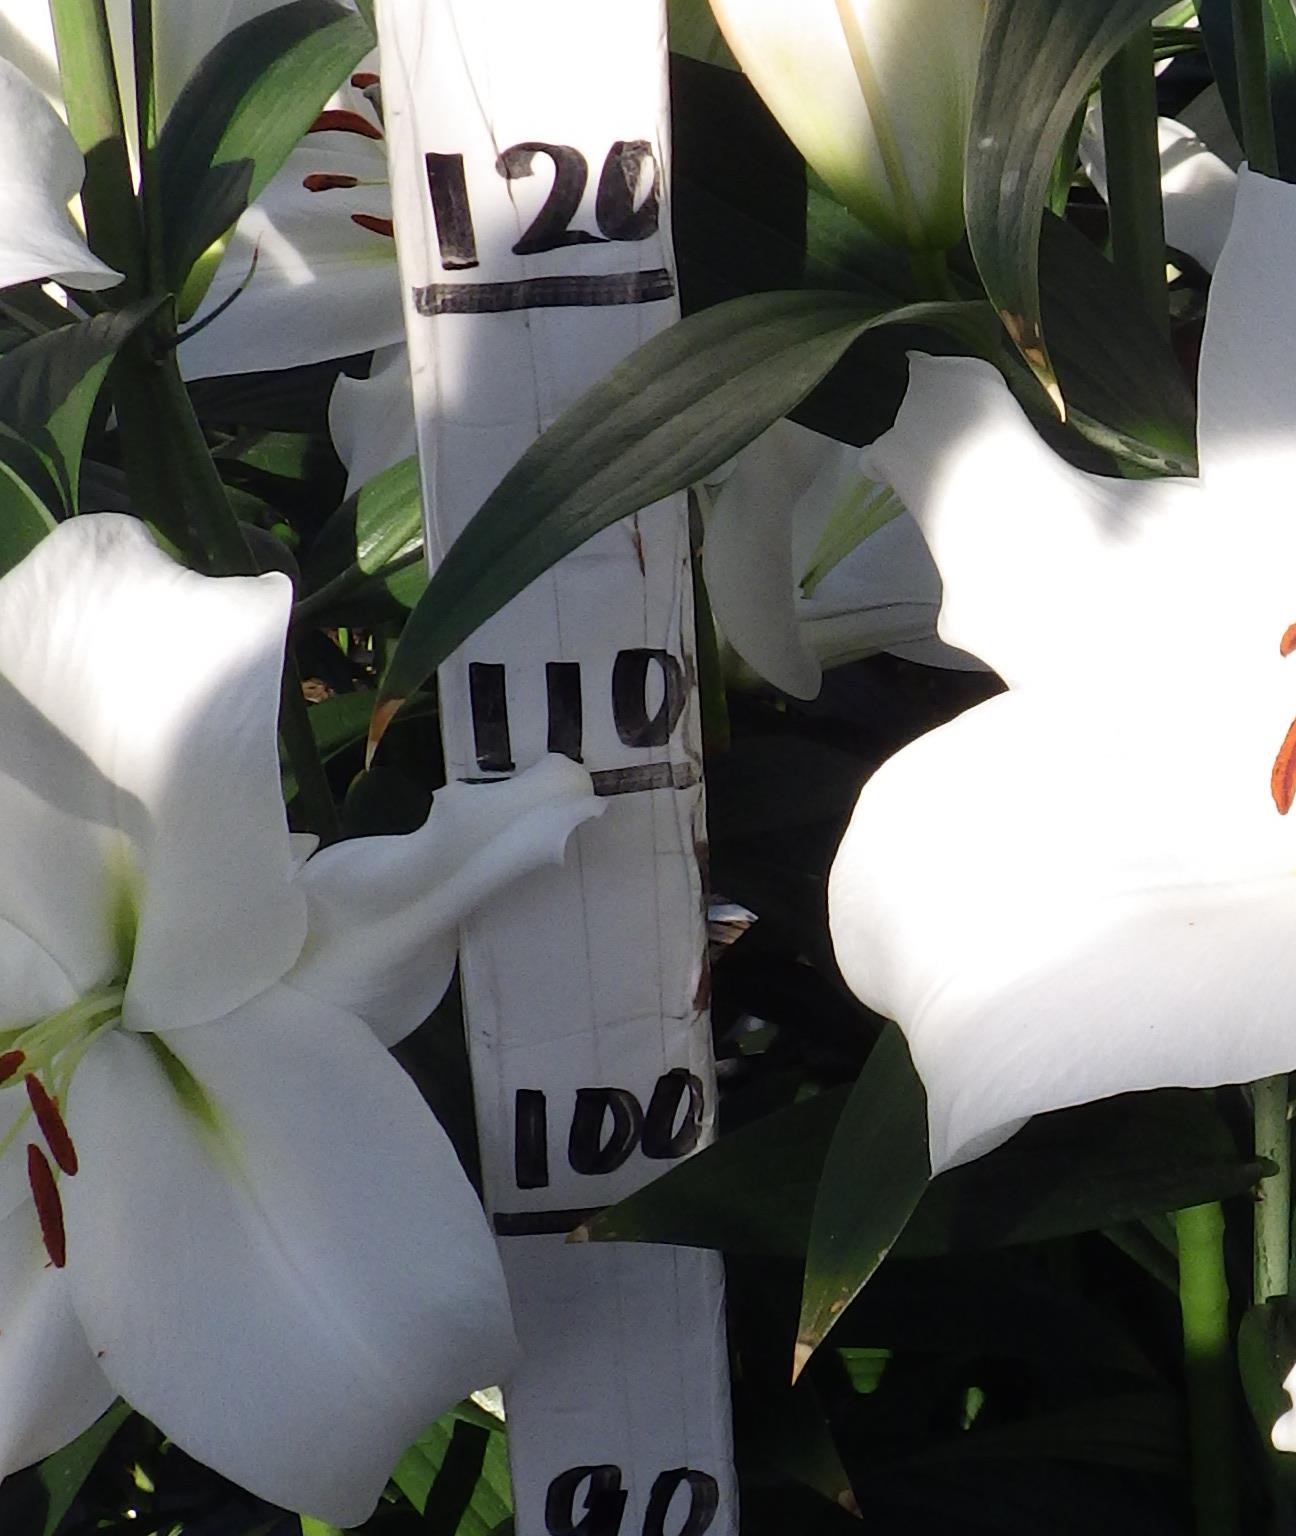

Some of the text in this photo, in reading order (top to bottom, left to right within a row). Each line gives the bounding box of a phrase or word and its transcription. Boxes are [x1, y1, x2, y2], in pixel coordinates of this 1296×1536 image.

[425, 140, 660, 270] 120
[469, 648, 686, 772] 110
[514, 1068, 705, 1189] 100
